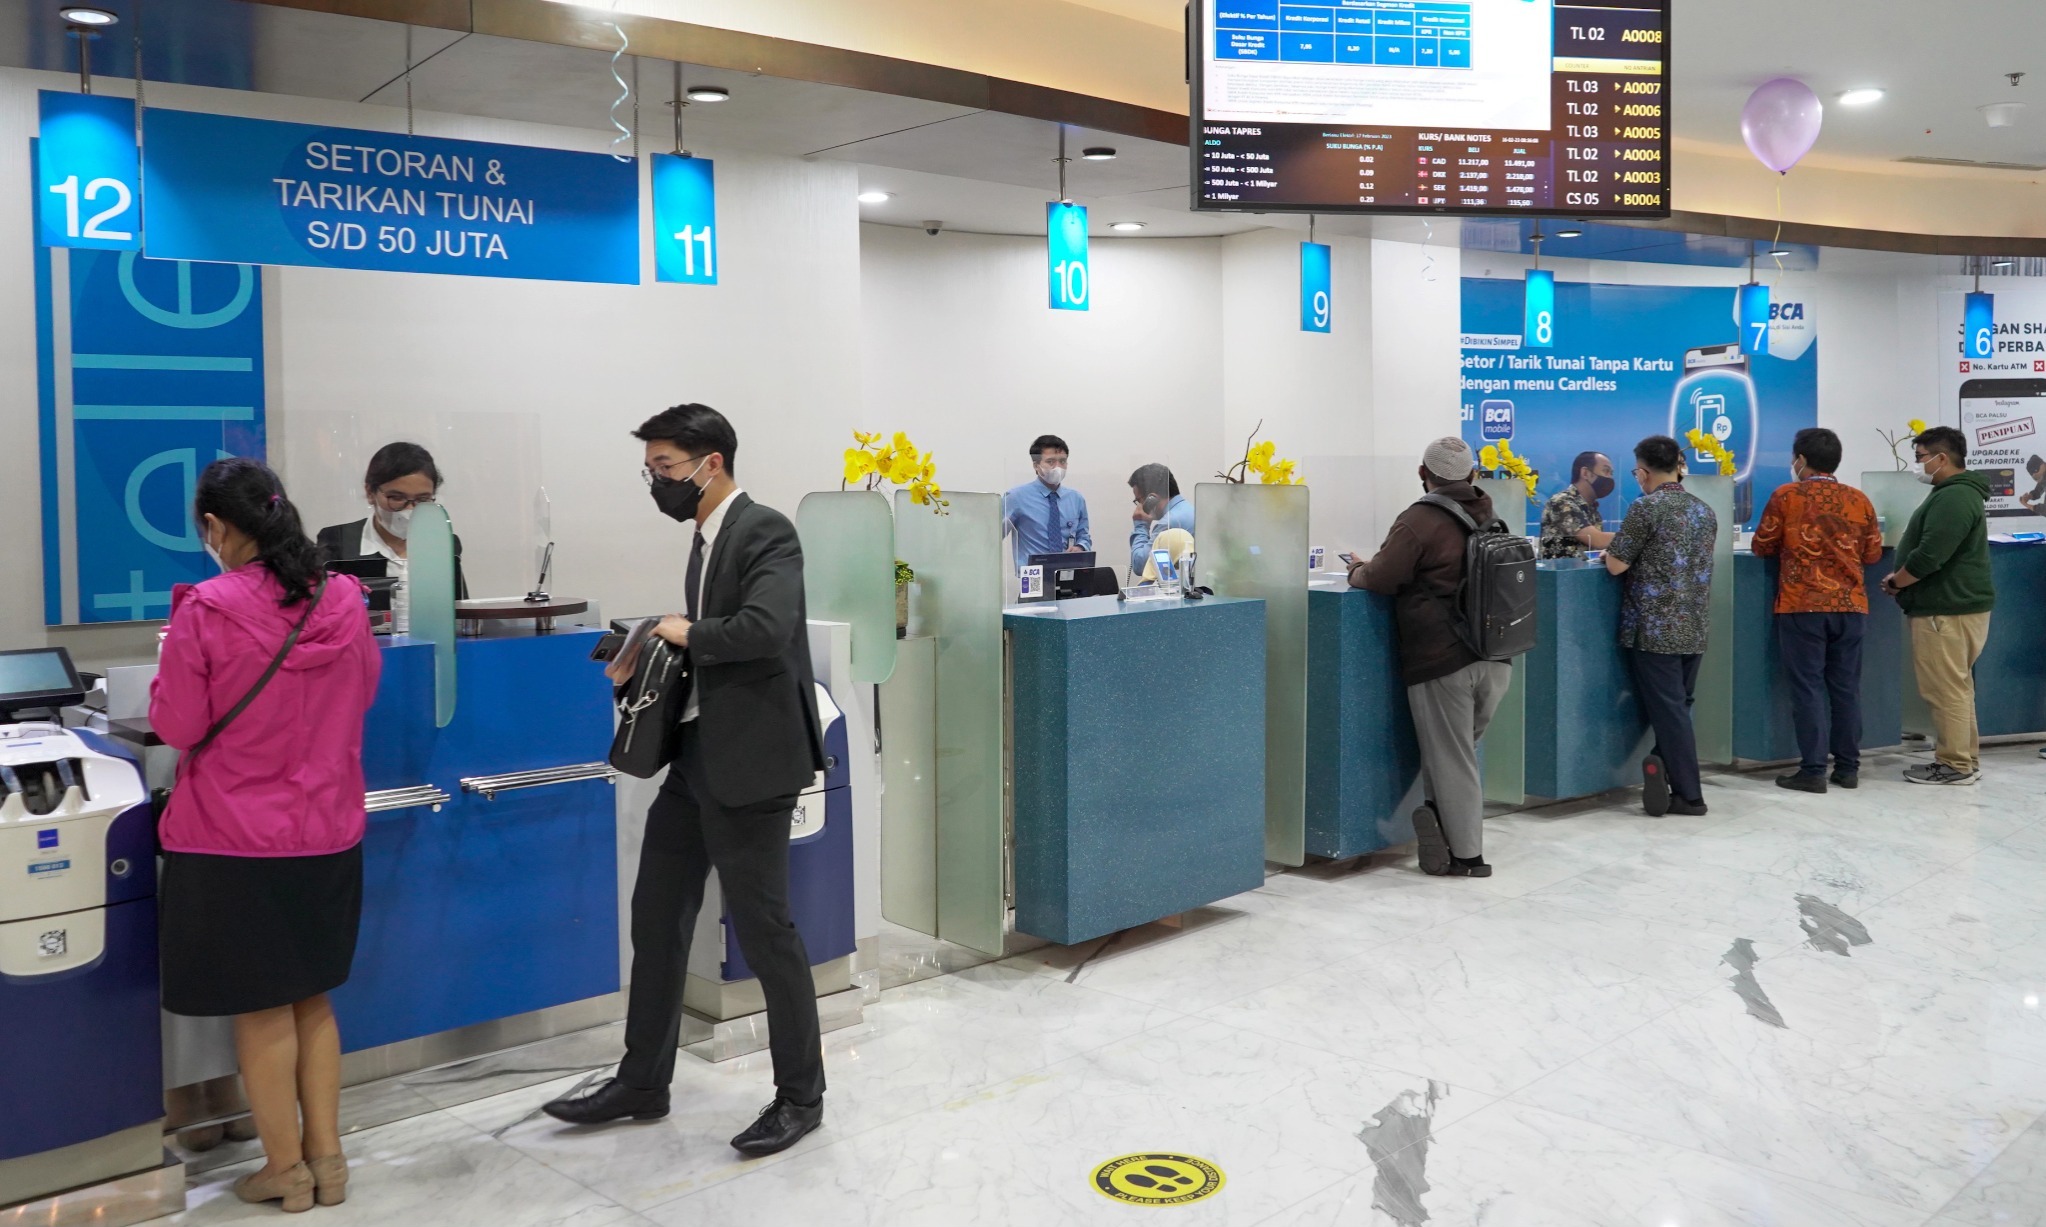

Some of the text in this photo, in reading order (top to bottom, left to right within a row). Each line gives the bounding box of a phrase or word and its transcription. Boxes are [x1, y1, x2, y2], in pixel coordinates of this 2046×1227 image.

[1570, 26, 1605, 41] TL 02
[1621, 29, 1662, 43] A0008
[1566, 80, 1599, 93] TL 03
[1623, 82, 1661, 94] A0007
[1566, 103, 1599, 116] TL 02
[1623, 105, 1661, 117] A0006
[1232, 127, 1262, 136] TAPRES
[1418, 132, 1492, 143] KURS/ BANK NOTES
[1566, 125, 1599, 138] TL 03
[1623, 127, 1661, 139] A0005
[1221, 152, 1236, 160] Juta
[1566, 148, 1599, 161] TL 02
[1623, 150, 1661, 162] A0004
[305, 141, 507, 187] SETORAN &
[1211, 165, 1220, 173] 50
[1246, 166, 1259, 174] 500
[1566, 170, 1599, 183] TL 02
[1623, 172, 1661, 184] A0003
[1211, 179, 1225, 187] 500
[1225, 179, 1239, 187] Juta
[1256, 180, 1278, 189] Milyar
[273, 178, 535, 226] TARIKAN TUNAI
[1217, 193, 1239, 201] Milyar
[1566, 192, 1599, 205] CS 05
[1624, 194, 1661, 206] B0004
[49, 175, 133, 241] 12
[307, 220, 509, 261] S/D 50 JUTA
[674, 224, 713, 278] 11
[1053, 259, 1088, 306] 10
[1313, 290, 1329, 328] 9
[1767, 302, 1804, 321] BCA
[1536, 310, 1552, 345] 8
[1958, 322, 2046, 335] JGAN SH
[1751, 322, 1768, 351] 7
[1976, 327, 1991, 356] 6
[1461, 354, 1674, 374] Setor / Tarik Tunai Tanpa Kartu
[1972, 362, 2028, 371] No. Kartu ATM
[1461, 375, 1617, 394] dengan menu Cardless
[1461, 403, 1475, 421] di
[1484, 408, 1512, 423] BCA
[1484, 423, 1512, 434] mobile
[1716, 423, 1728, 434] Rp
[1981, 422, 2030, 441] PENIPUAN
[1972, 448, 2021, 457] UPGRADE KE
[1984, 457, 2026, 465] PRIORITAS
[1028, 568, 1040, 576] BCA
[1116, 1155, 1149, 1166] HERE
[1114, 1192, 1161, 1205] PLEASE
[1164, 1193, 1196, 1205] KEEP
